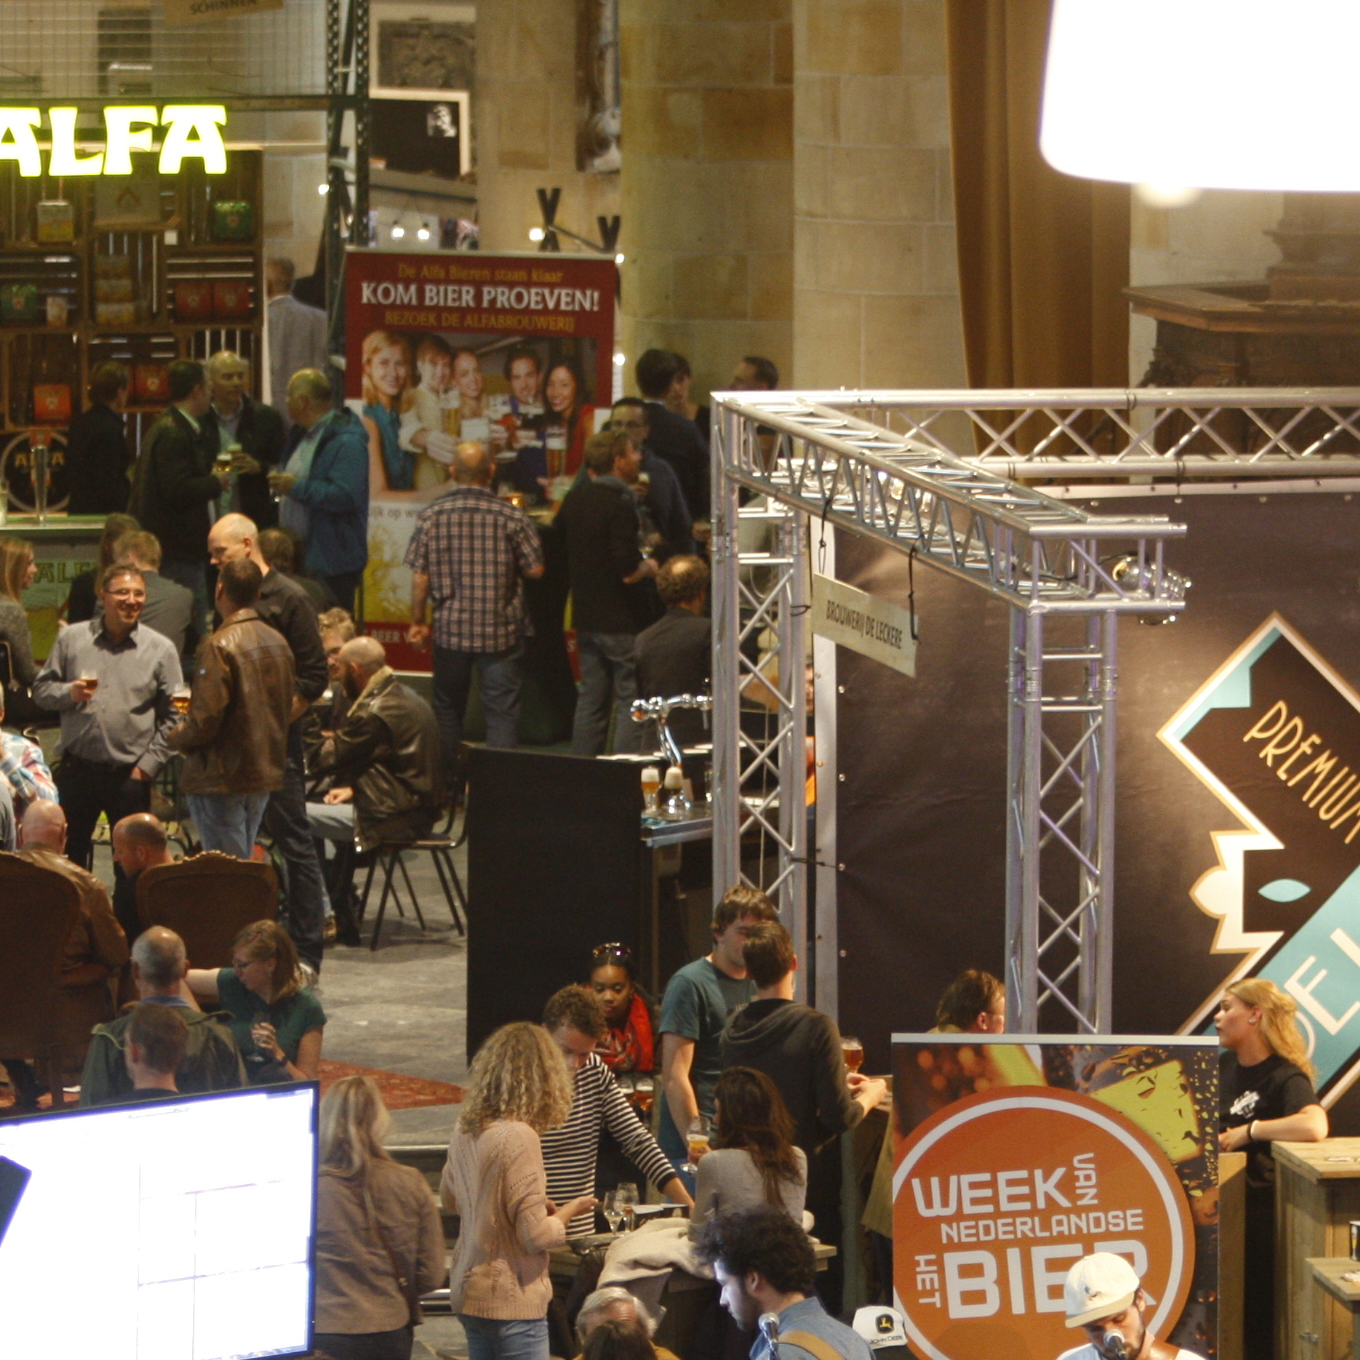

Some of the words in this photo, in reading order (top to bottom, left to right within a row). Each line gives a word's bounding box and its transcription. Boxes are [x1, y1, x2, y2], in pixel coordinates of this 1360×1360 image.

[398, 264, 416, 279] De
[420, 264, 444, 279] Alfa
[449, 265, 489, 280] Bieren
[494, 267, 527, 281] staan
[531, 267, 564, 282] klaar
[361, 282, 418, 305] KOM
[424, 284, 476, 307] BIER
[482, 285, 600, 312] PROEVEN!
[385, 311, 437, 327] BEZOEK
[442, 313, 461, 327] DE
[464, 314, 575, 333] ALFABROUWERIJ
[14, 451, 65, 468] ALA
[35, 562, 91, 583] ALF
[826, 600, 865, 637] BROUWERIJ
[865, 615, 875, 638] DE
[875, 620, 902, 650] LECKERE
[911, 1166, 1072, 1218] WEEK
[1073, 1152, 1099, 1206] VAN
[940, 1209, 1144, 1244] NEDERLANDSE
[914, 1254, 942, 1308] HET
